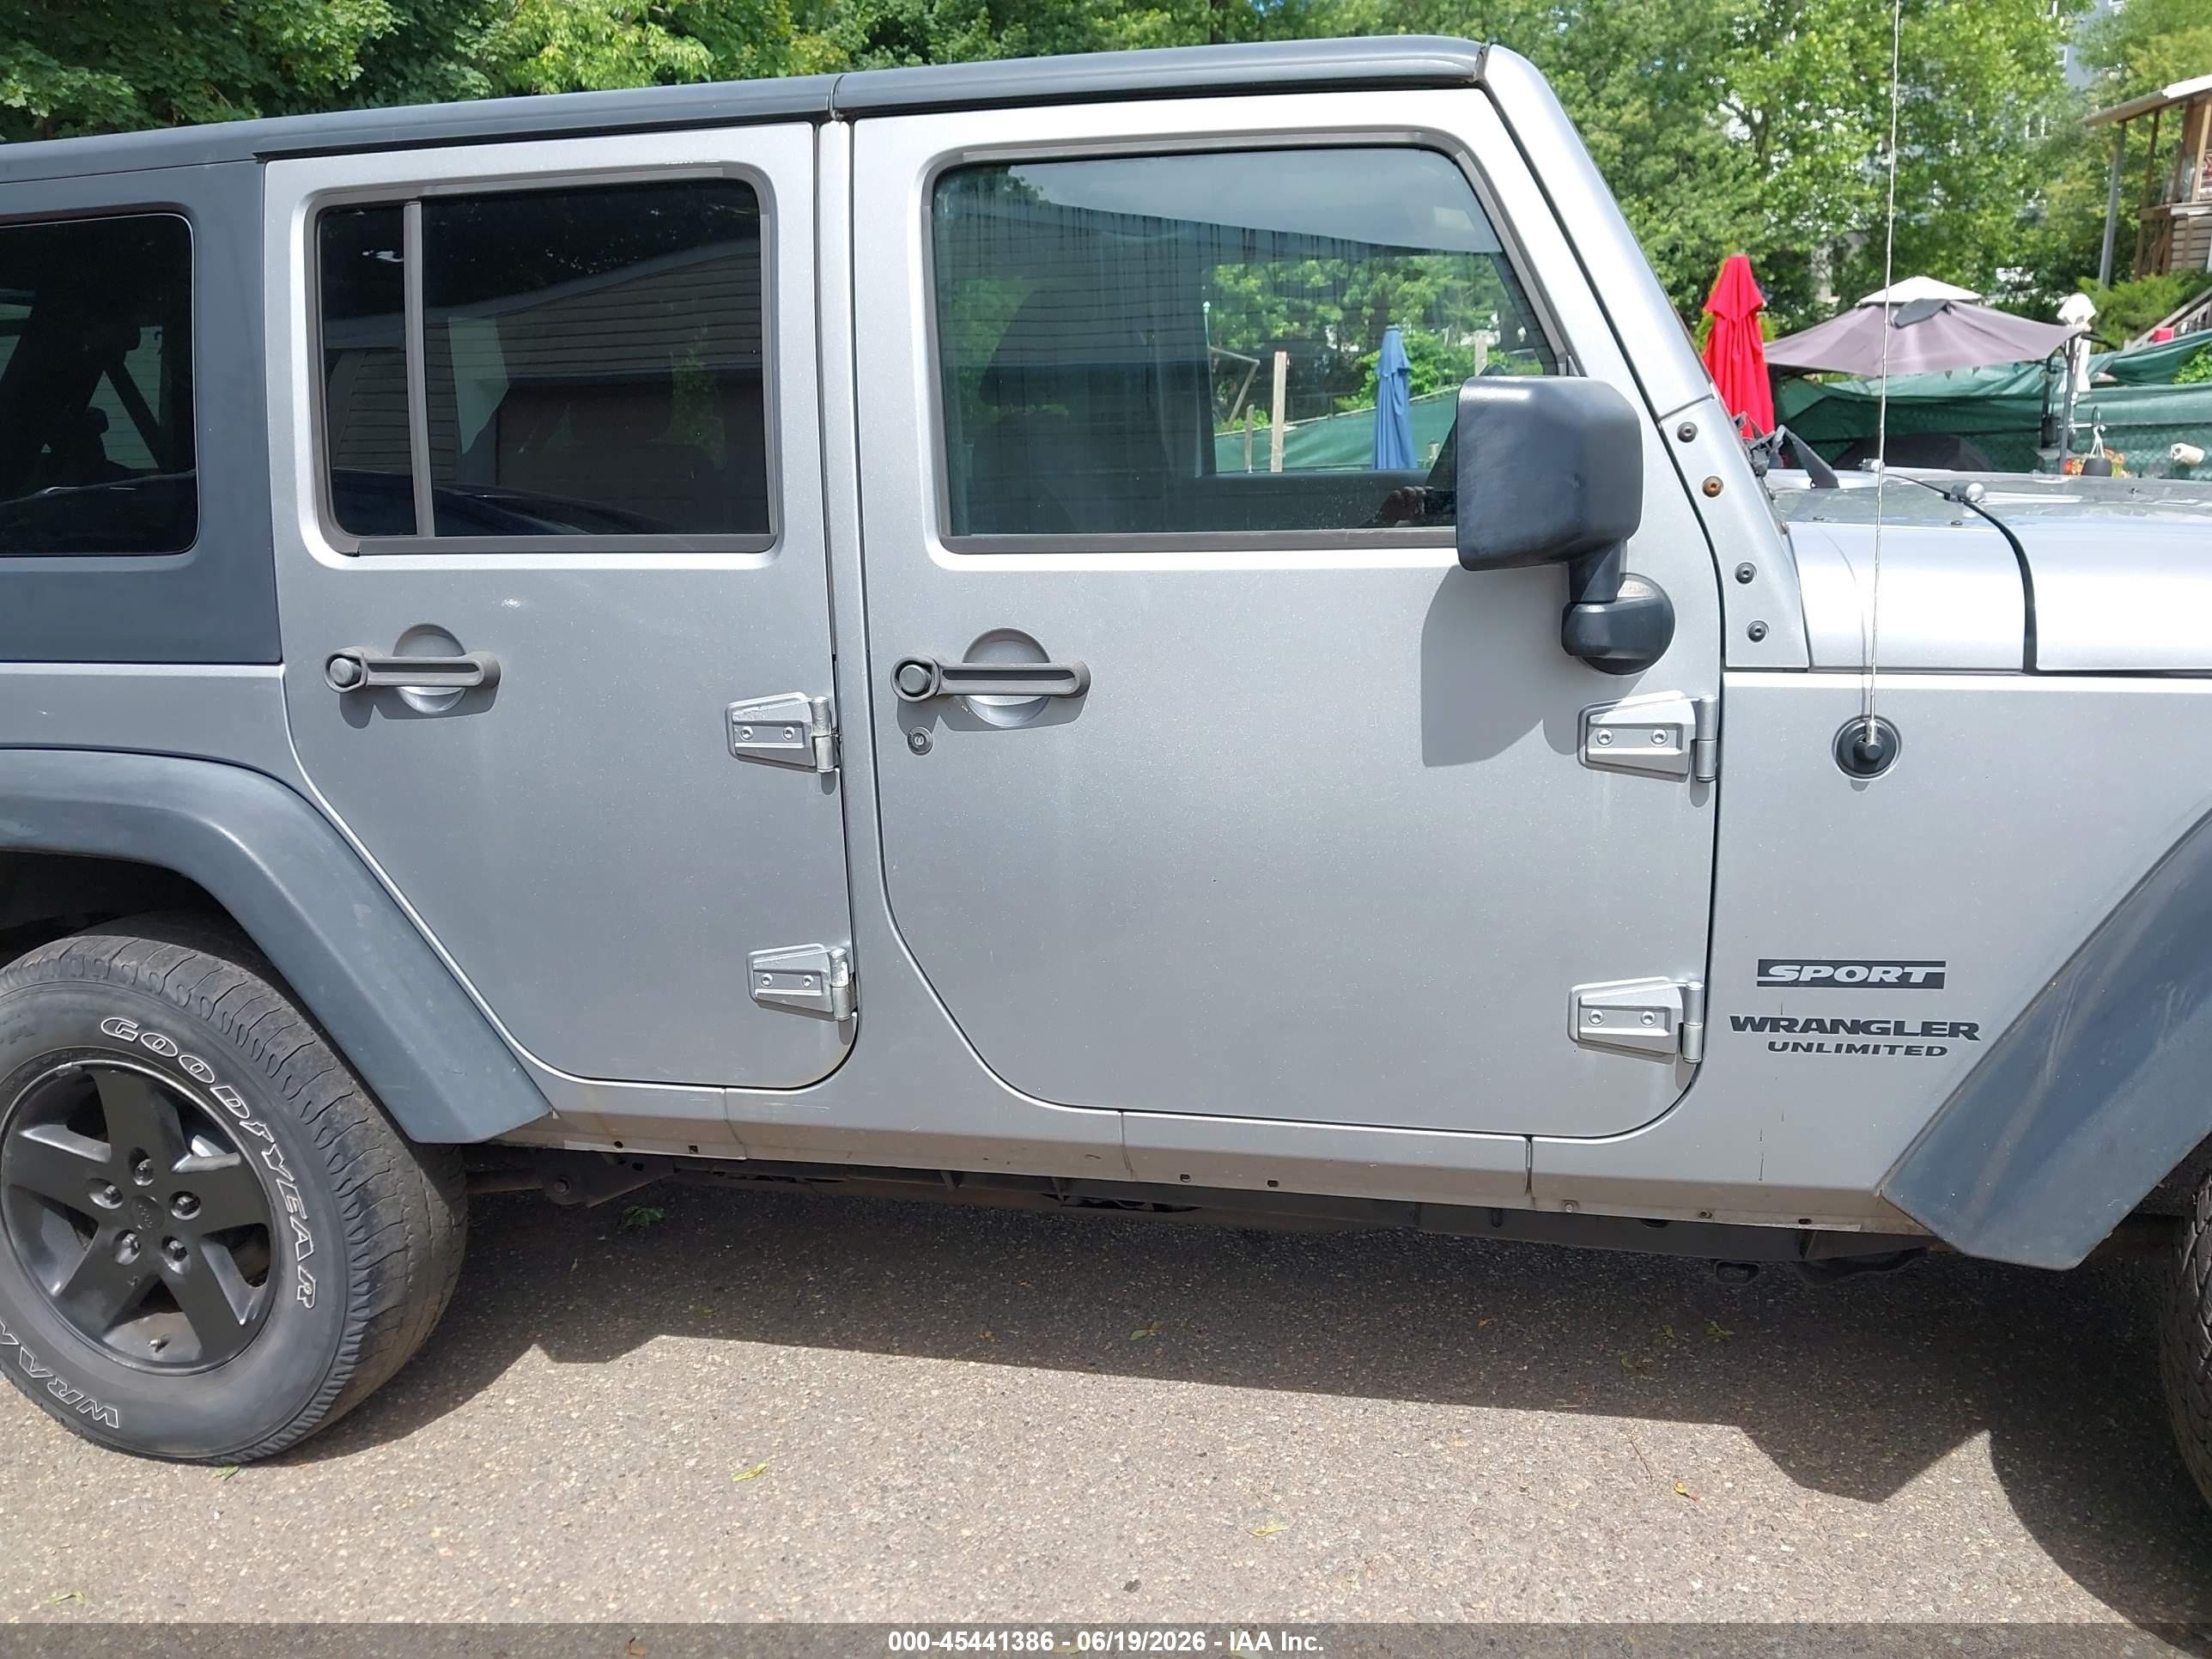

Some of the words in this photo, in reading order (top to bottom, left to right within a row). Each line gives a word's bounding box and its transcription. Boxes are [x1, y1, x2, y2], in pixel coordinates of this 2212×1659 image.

[1757, 963, 1946, 985] SPORT
[1729, 1015, 1981, 1042] WRANGLER
[1767, 1040, 1948, 1057] UNLIMITED
[100, 1016, 317, 1309] GOODYEAR
